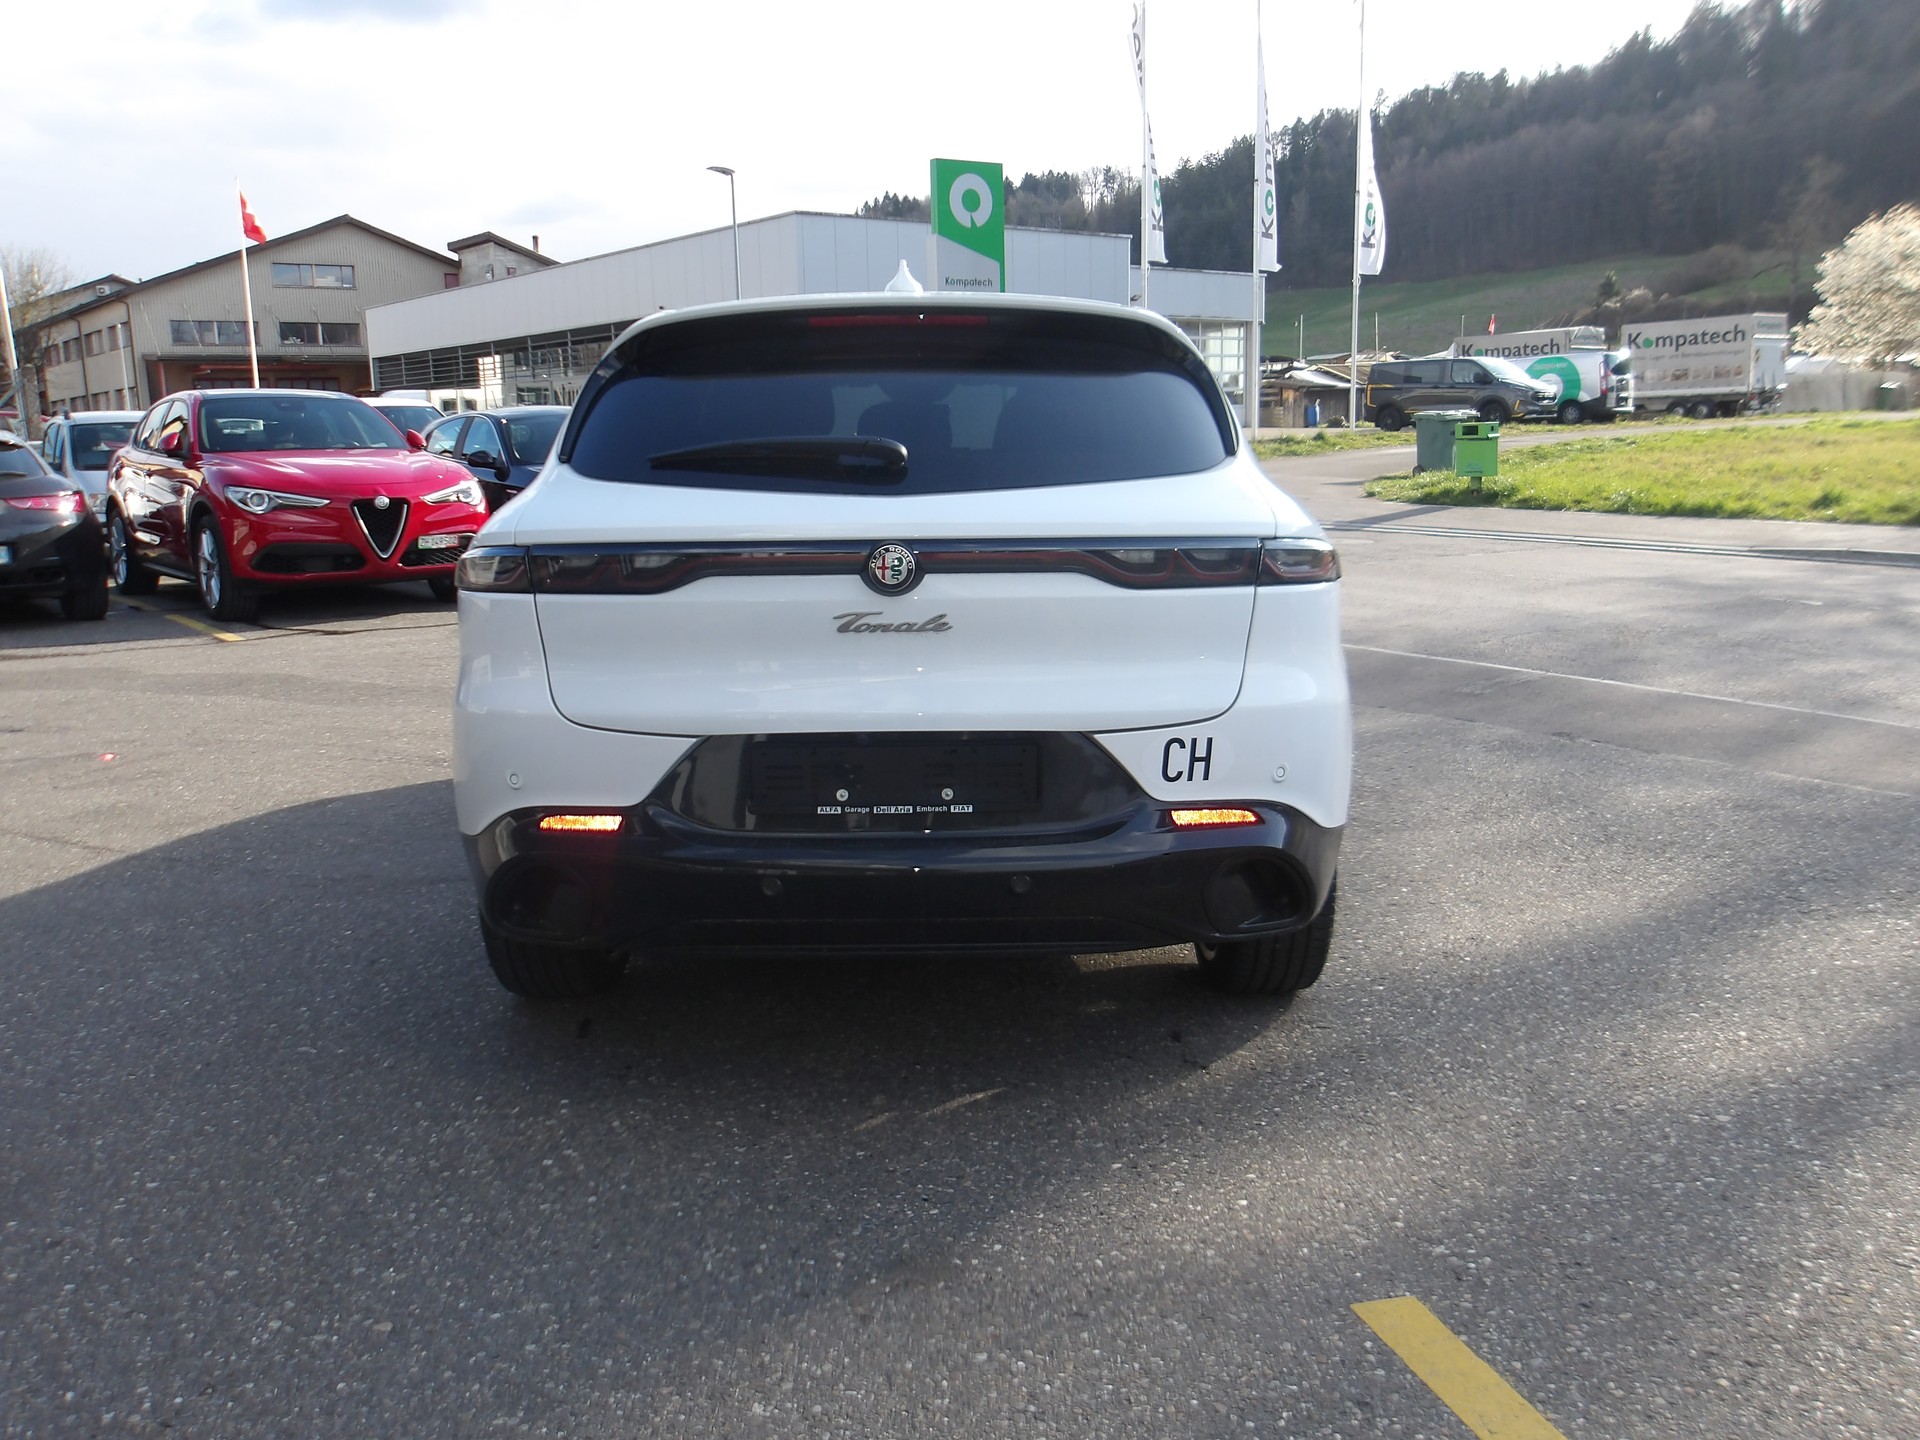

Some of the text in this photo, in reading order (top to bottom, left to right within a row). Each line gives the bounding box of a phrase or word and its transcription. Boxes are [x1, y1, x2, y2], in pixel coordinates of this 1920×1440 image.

[944, 275, 993, 288] Kompatech
[1627, 323, 1746, 351] Kompatech
[871, 546, 913, 570] ALFA ROMEO
[832, 611, 953, 633] Tonale
[1161, 737, 1213, 783] CH
